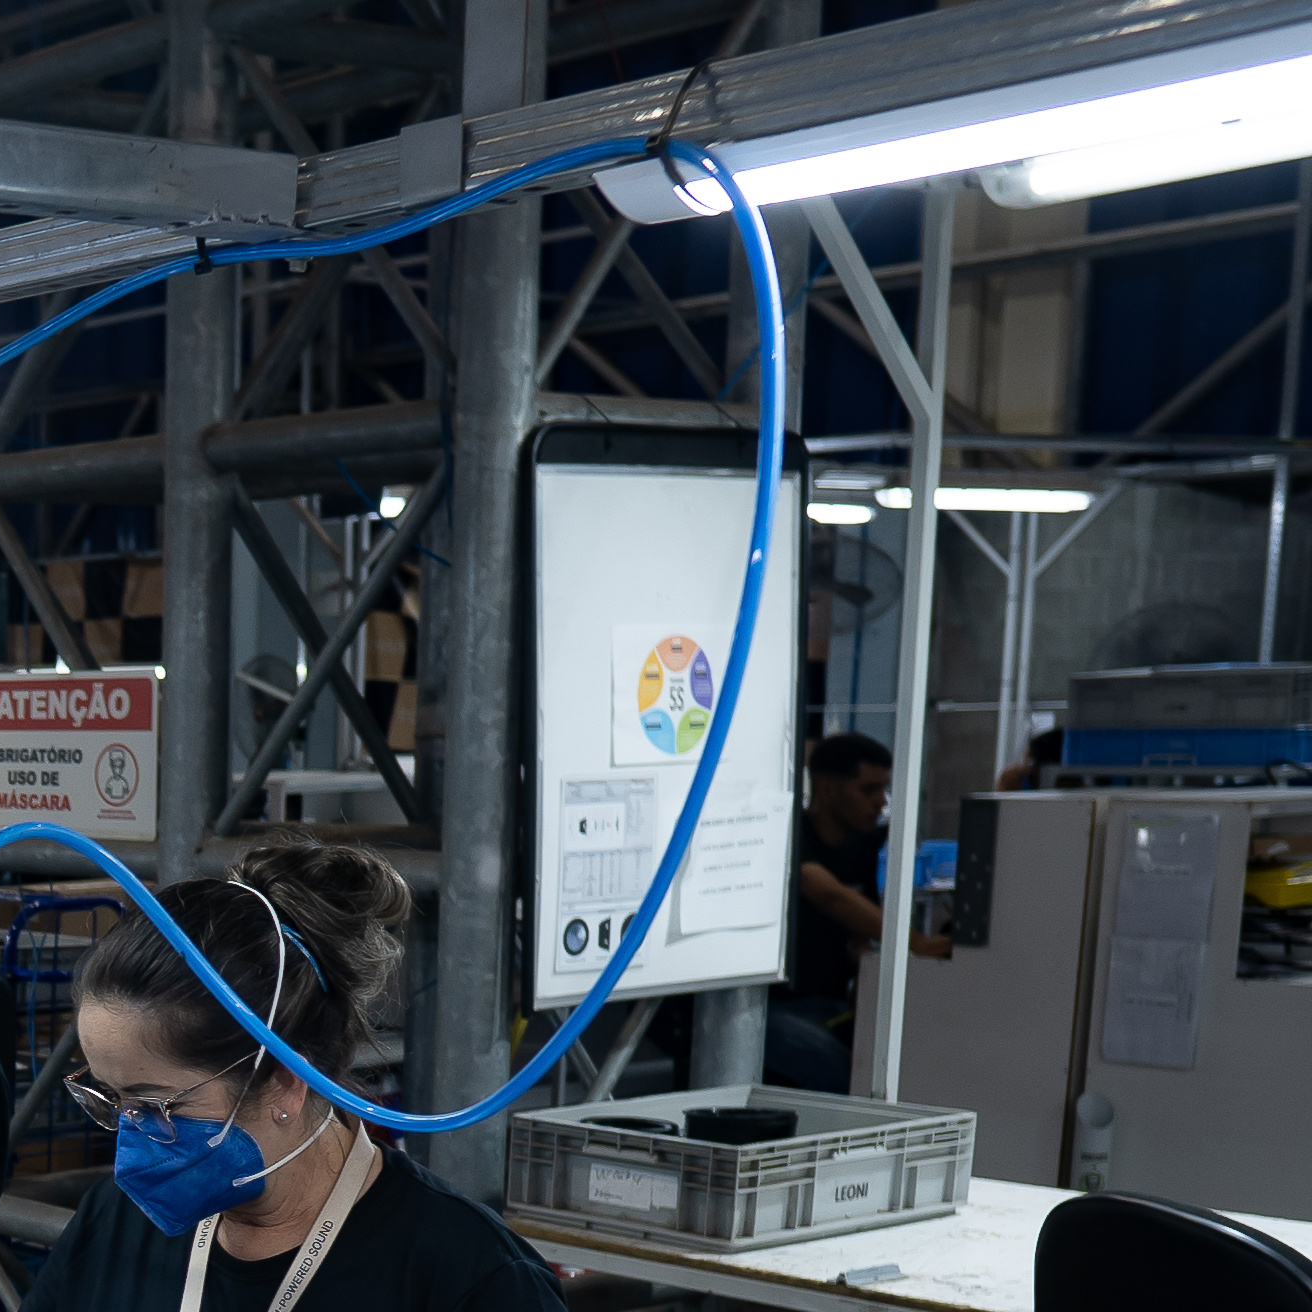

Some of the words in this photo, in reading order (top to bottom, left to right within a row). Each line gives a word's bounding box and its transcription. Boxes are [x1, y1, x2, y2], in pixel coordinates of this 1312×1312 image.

[8, 770, 37, 785] USO
[41, 771, 60, 786] DE
[835, 1182, 869, 1203] LEONI
[198, 1216, 213, 1248] OUND
[308, 1220, 334, 1257] SOUND
